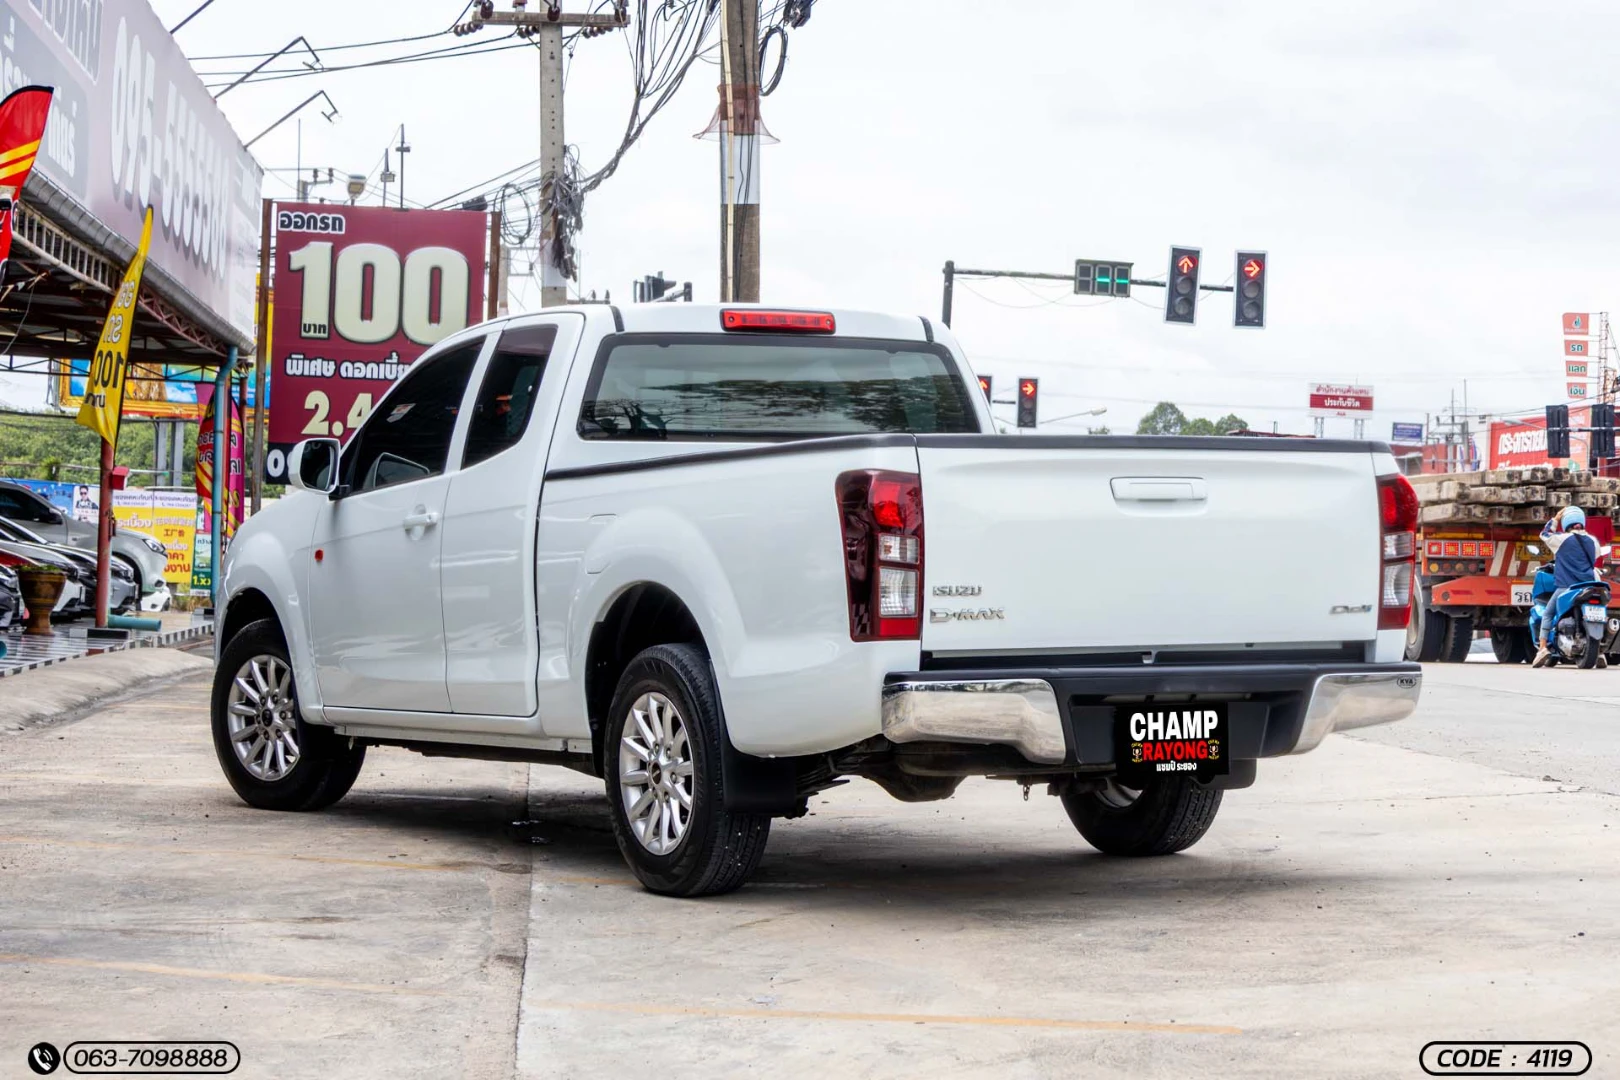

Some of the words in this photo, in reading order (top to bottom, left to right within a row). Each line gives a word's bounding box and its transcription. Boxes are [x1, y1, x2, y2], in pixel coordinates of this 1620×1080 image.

[279, 213, 345, 233] ออกรถ
[289, 241, 470, 345] 100
[303, 323, 327, 334] บาท
[286, 354, 336, 377] พิเศษ
[932, 585, 982, 597] ISUZU
